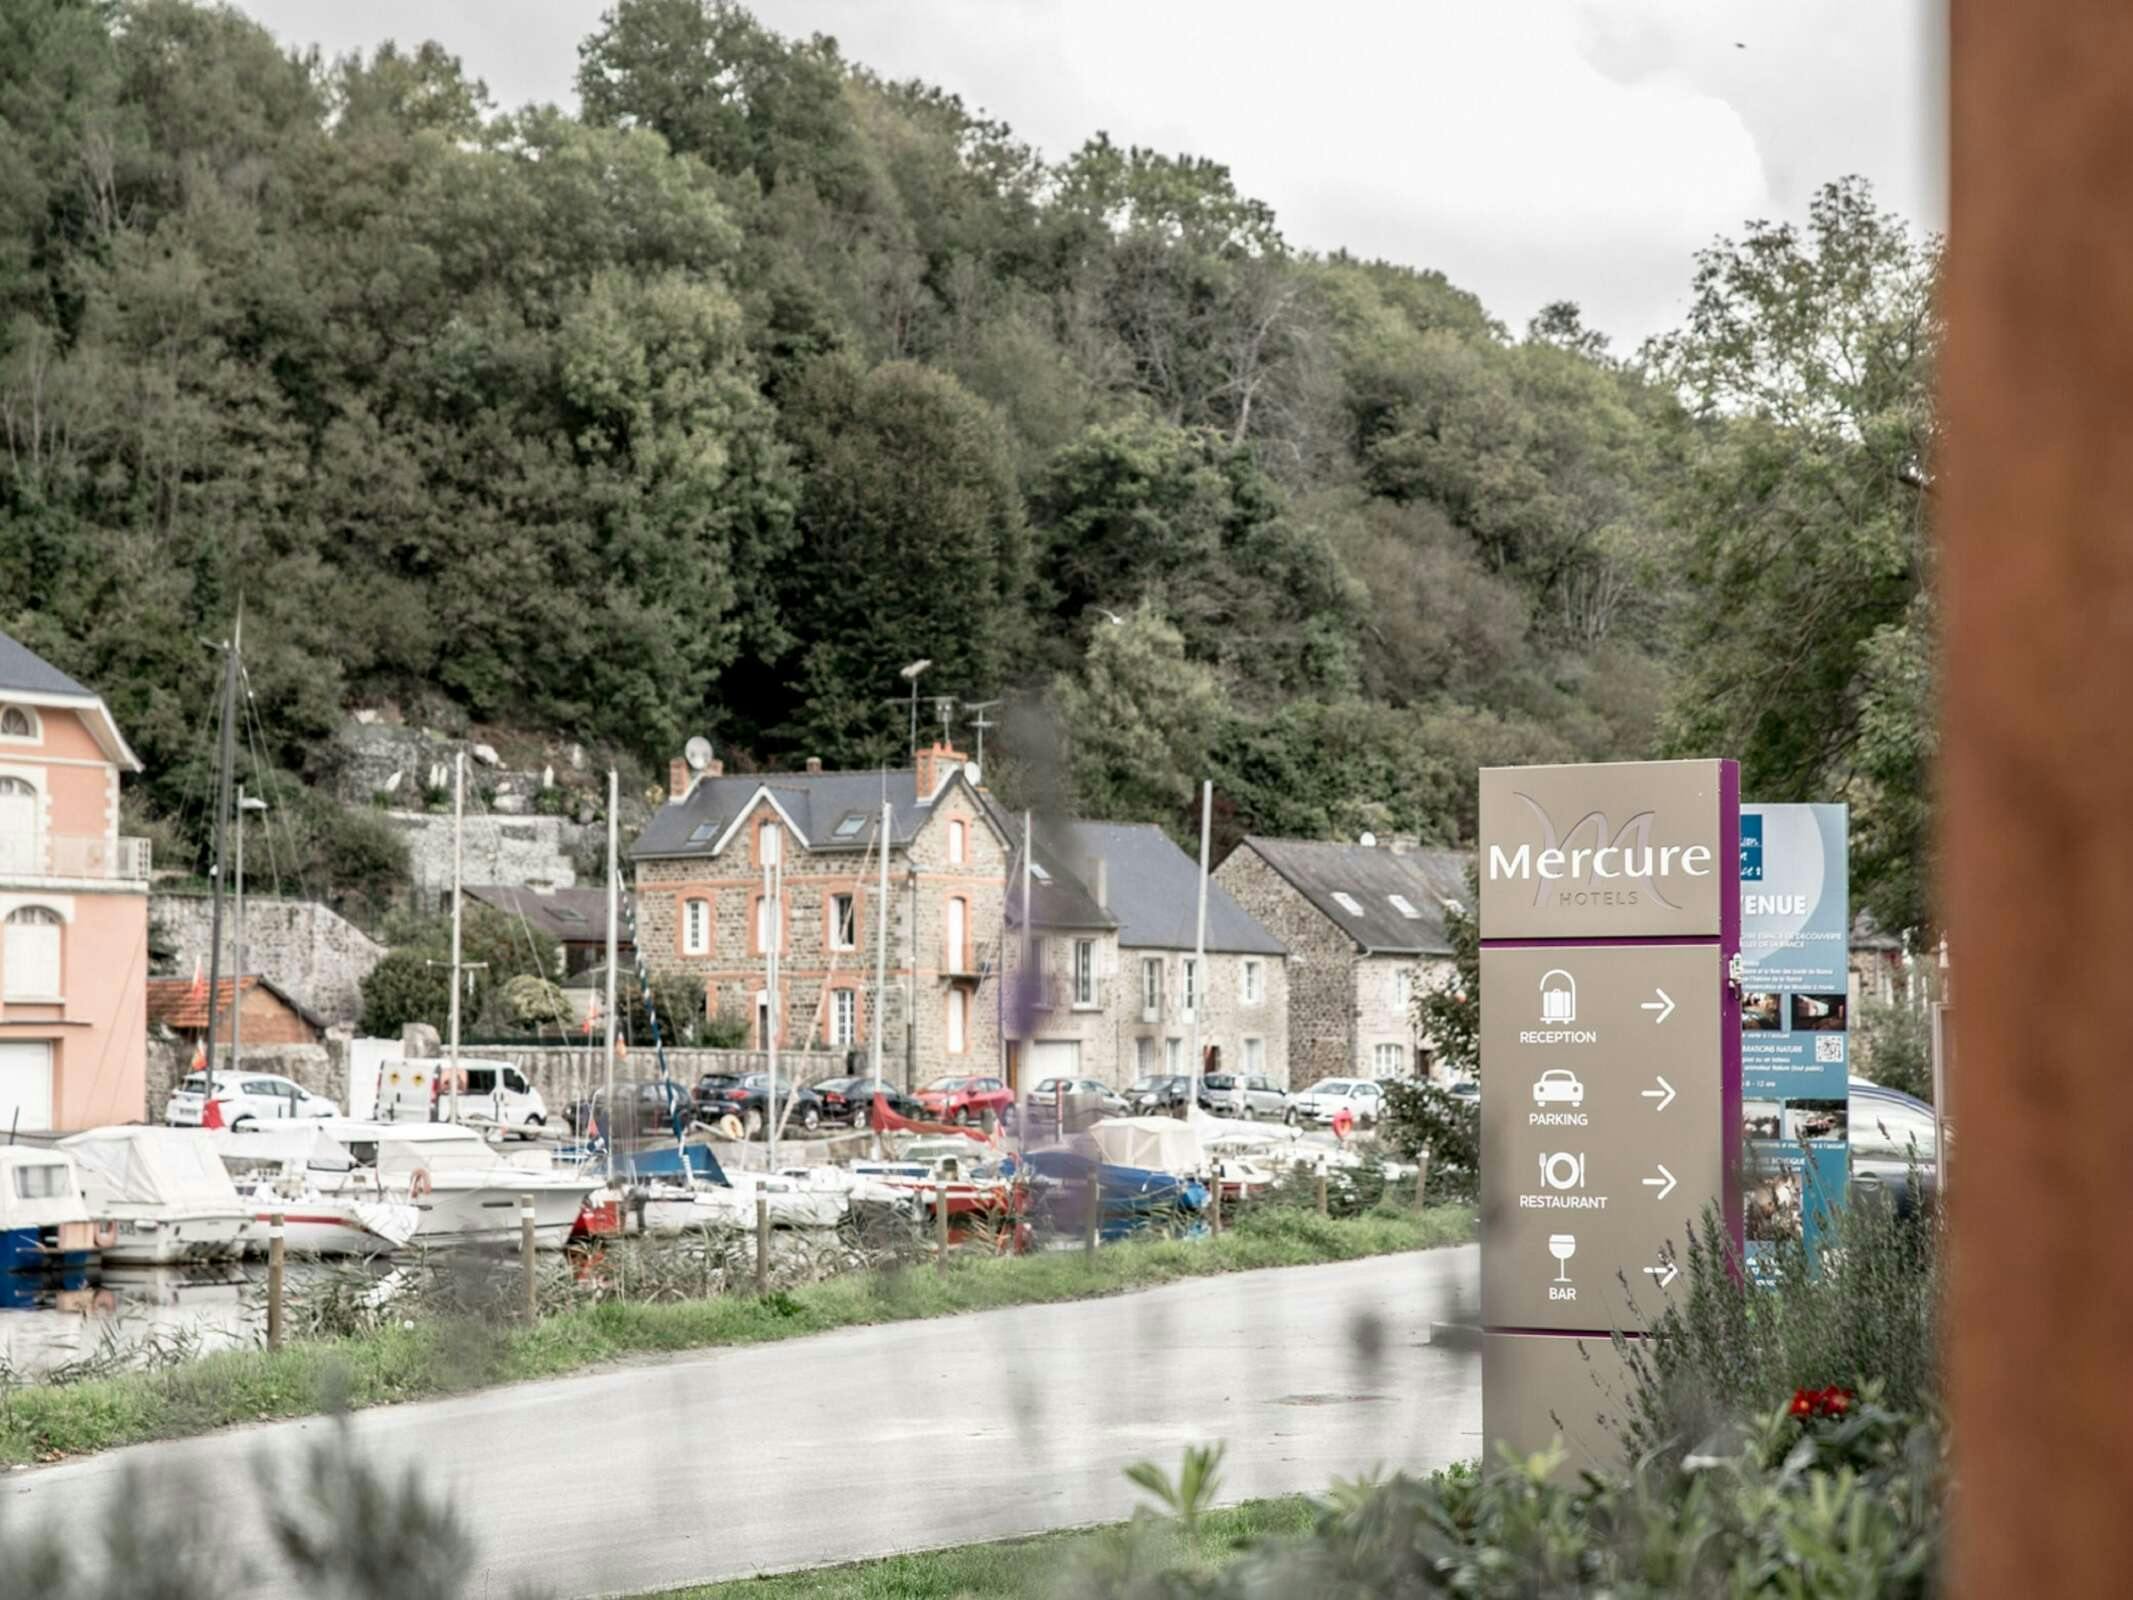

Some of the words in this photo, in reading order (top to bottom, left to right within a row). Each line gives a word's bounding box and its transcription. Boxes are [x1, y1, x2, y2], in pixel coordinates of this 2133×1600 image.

[1489, 844, 1712, 880] Mercure
[1559, 891, 1639, 906] HOTELS
[1741, 895, 1807, 915] ENUE
[1519, 1031, 1597, 1044] RECEPTION
[1529, 1113, 1588, 1127] PARKING
[1519, 1195, 1608, 1209] RESTAURANT
[1549, 1287, 1577, 1301] BAR
